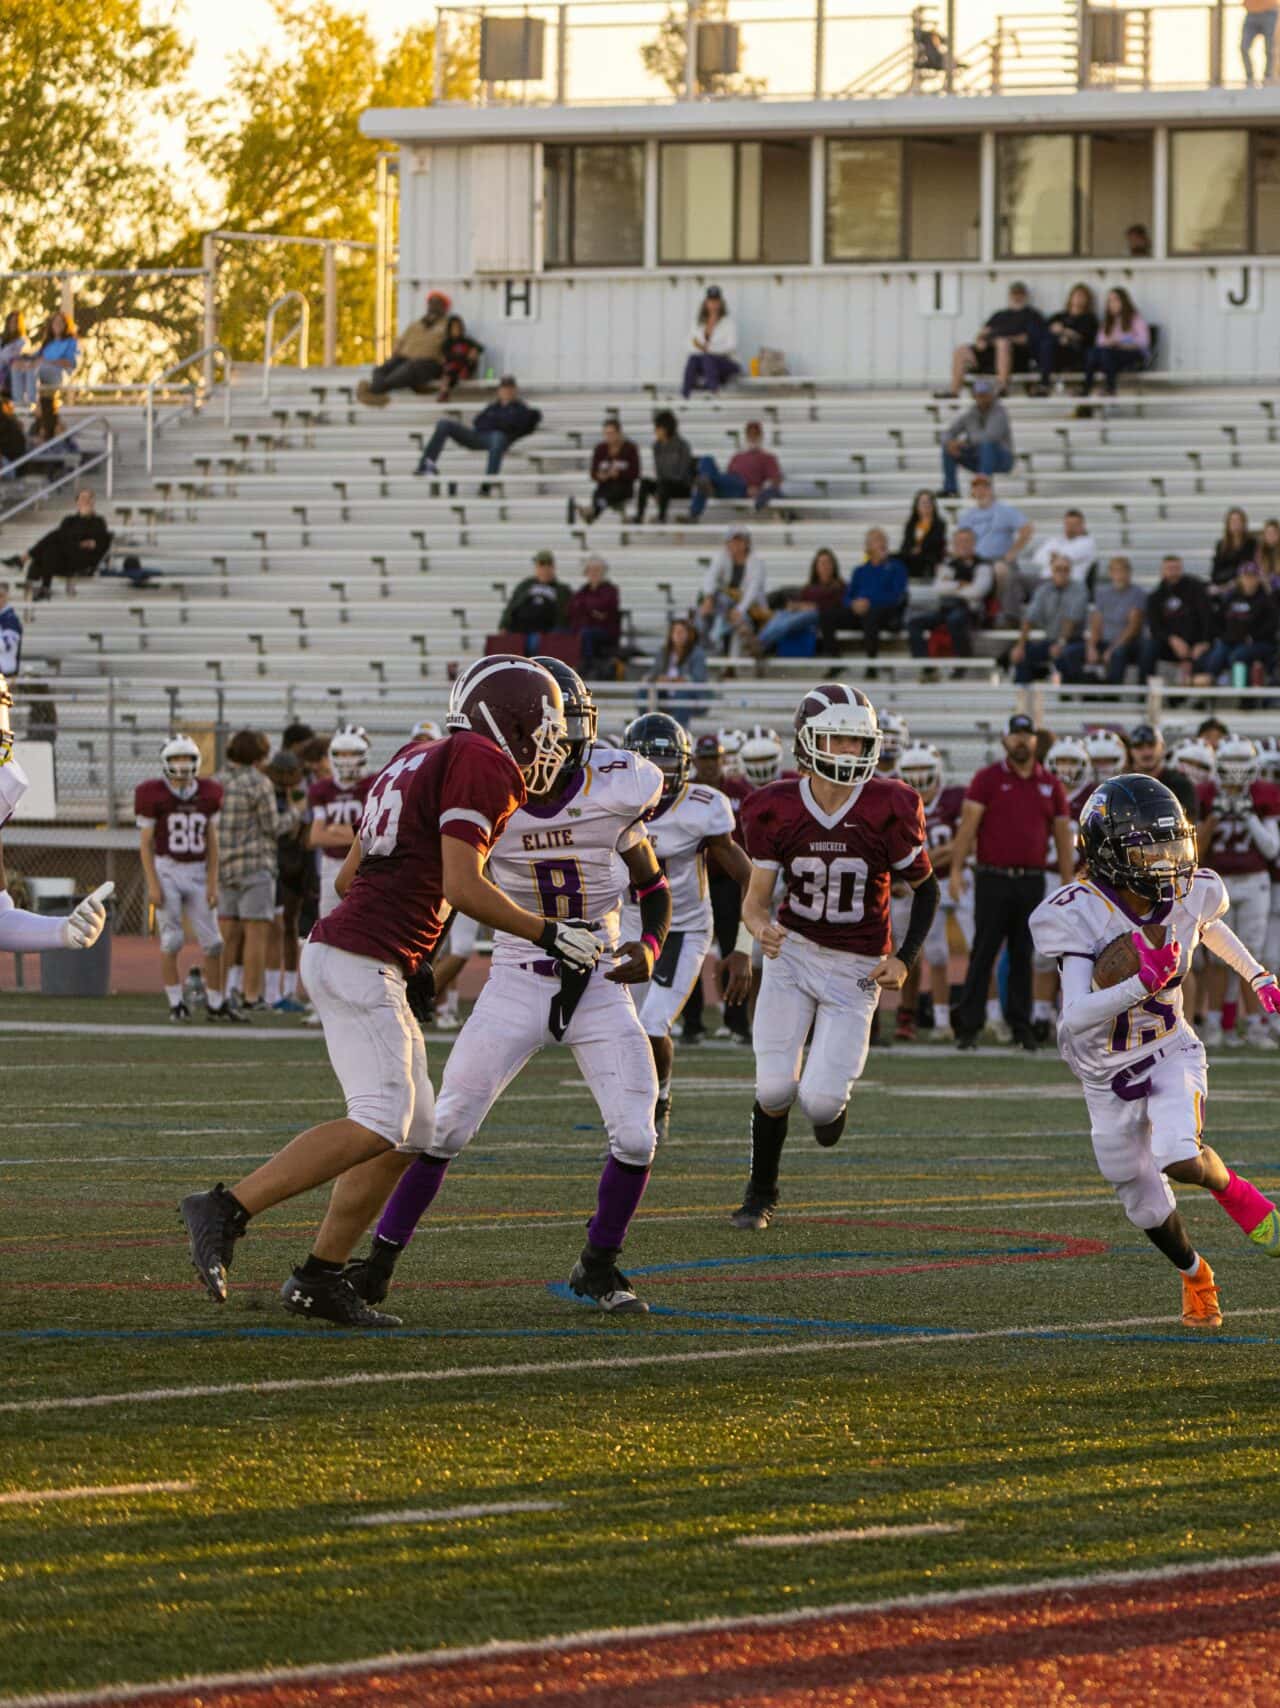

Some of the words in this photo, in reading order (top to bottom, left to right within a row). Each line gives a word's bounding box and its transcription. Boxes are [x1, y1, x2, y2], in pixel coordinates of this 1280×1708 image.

[505, 277, 531, 317] H
[934, 269, 943, 311] I
[1228, 265, 1249, 307] J
[167, 812, 208, 854] 80
[522, 828, 575, 852] ELITE
[789, 856, 869, 924] 30
